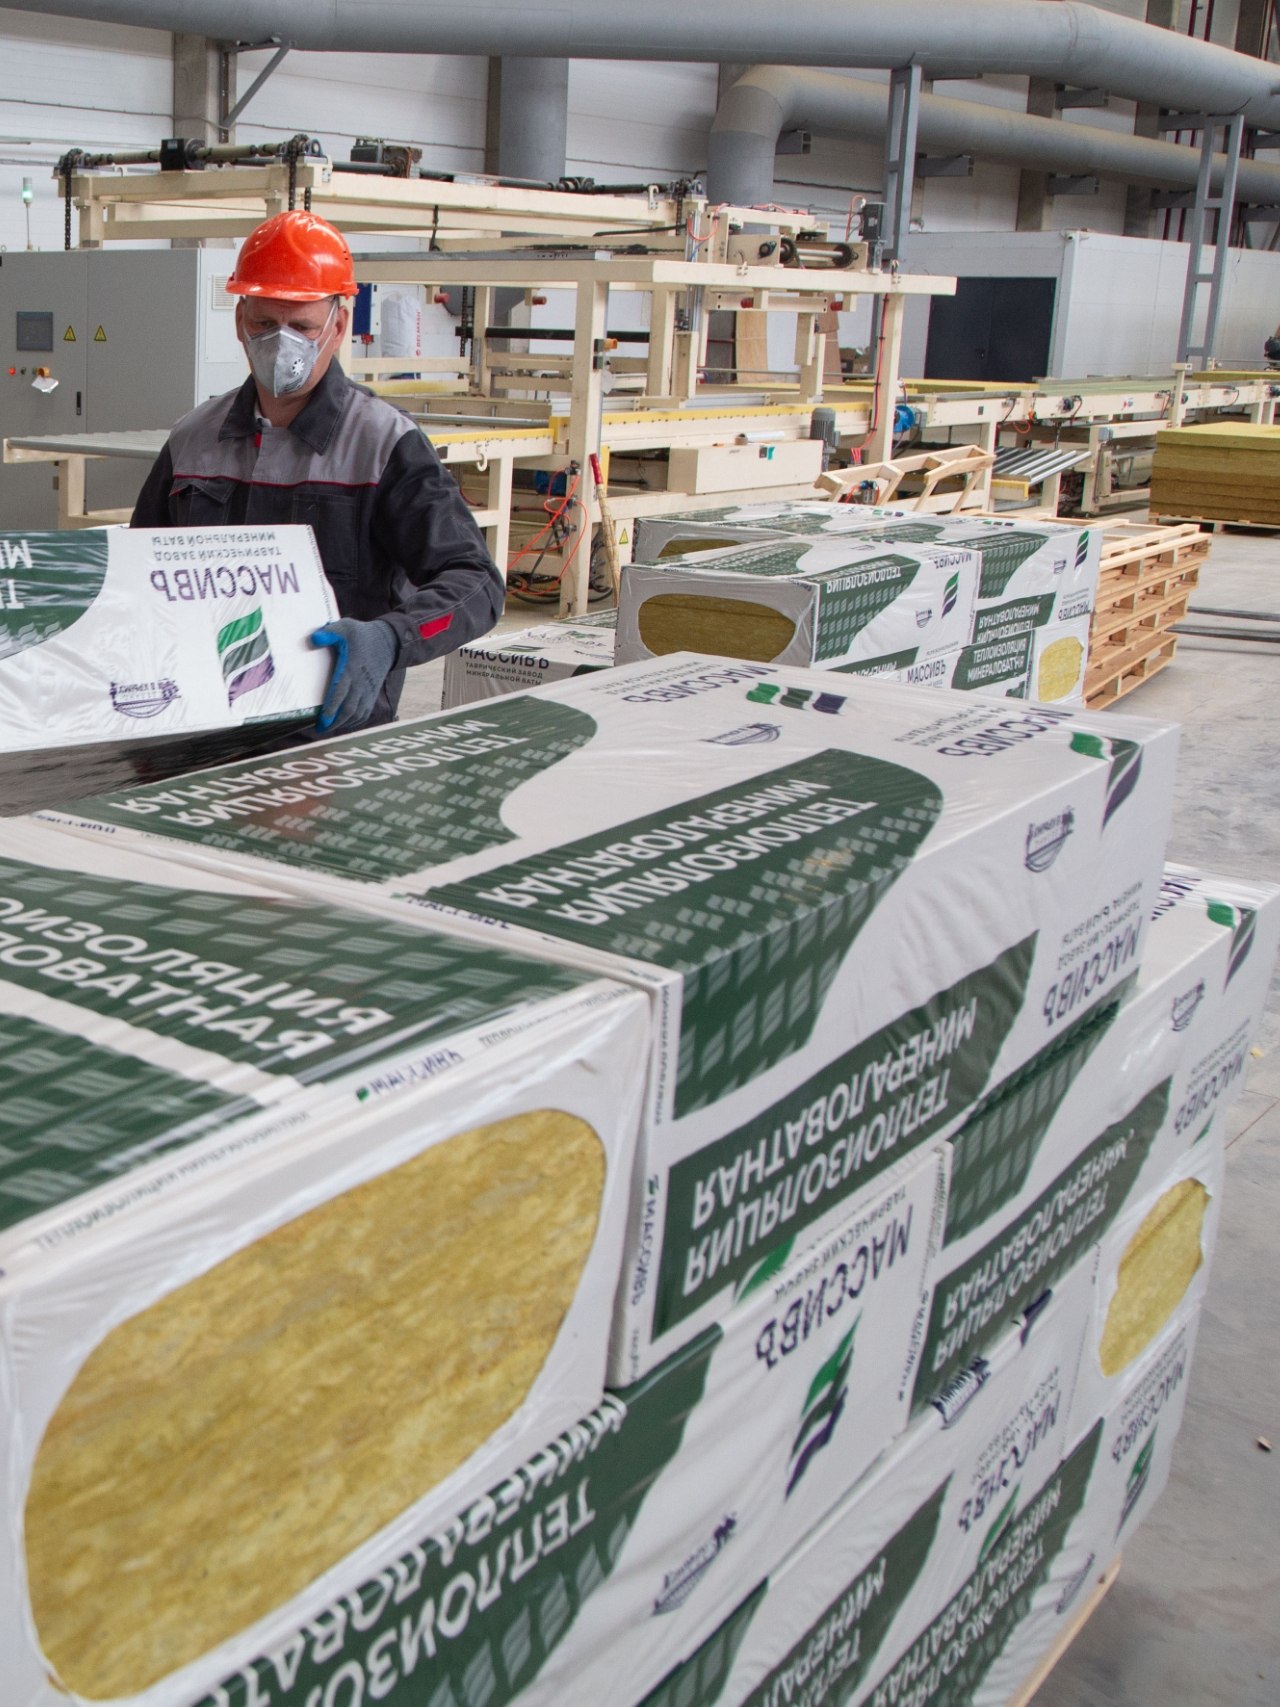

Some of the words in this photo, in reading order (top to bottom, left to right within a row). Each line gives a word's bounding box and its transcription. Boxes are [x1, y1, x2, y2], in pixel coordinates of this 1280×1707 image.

[151, 533, 185, 546] ВАТЫ
[153, 548, 196, 562] ЗАВОД
[186, 530, 275, 546] МИНЕРАЛЬНОЙ
[198, 545, 282, 562] ТАВРИЧЕСКИЙ
[150, 562, 299, 602] МАССИВЪ
[826, 566, 902, 594] ТЕПЛОИЗОЛЯЦИЯ
[977, 603, 1040, 630] МИНЕРАЛОВАТНАЯ
[459, 648, 550, 670] МАССИВЪ
[972, 638, 1027, 661] ТЕПЛОИЗОЛЯЦИЯ
[465, 661, 517, 675] ТАВРИЧЕСКИЙ
[518, 669, 543, 679] ЗАВОД
[466, 669, 520, 683] МИНЕРАЛЬНОЙ
[520, 678, 542, 686] ВАТЫ
[621, 664, 778, 705] МАССИВЪ
[906, 663, 947, 684] МАССИВЪ
[936, 707, 1075, 758] МАССИВЪ
[109, 719, 501, 815] МИНЕРАЛОВАТНАЯ
[161, 733, 531, 828] ТЕПЛОИЗОЛЯЦИЯ
[475, 777, 830, 909] МИНЕРАЛОВАТНАЯ
[545, 796, 879, 926] ТЕПЛОИЗОЛЯЦИЯ
[1043, 915, 1143, 1027] МАССИВЪ
[691, 996, 979, 1231] МИНЕРАЛОВАТНАЯ
[682, 1068, 952, 1297] ТЕПЛОИЗОЛЯЦИЯ
[755, 1202, 914, 1369] МАССИВЪ
[931, 1180, 1111, 1373] ТЕПЛОИЗОЛЯЦИЯ
